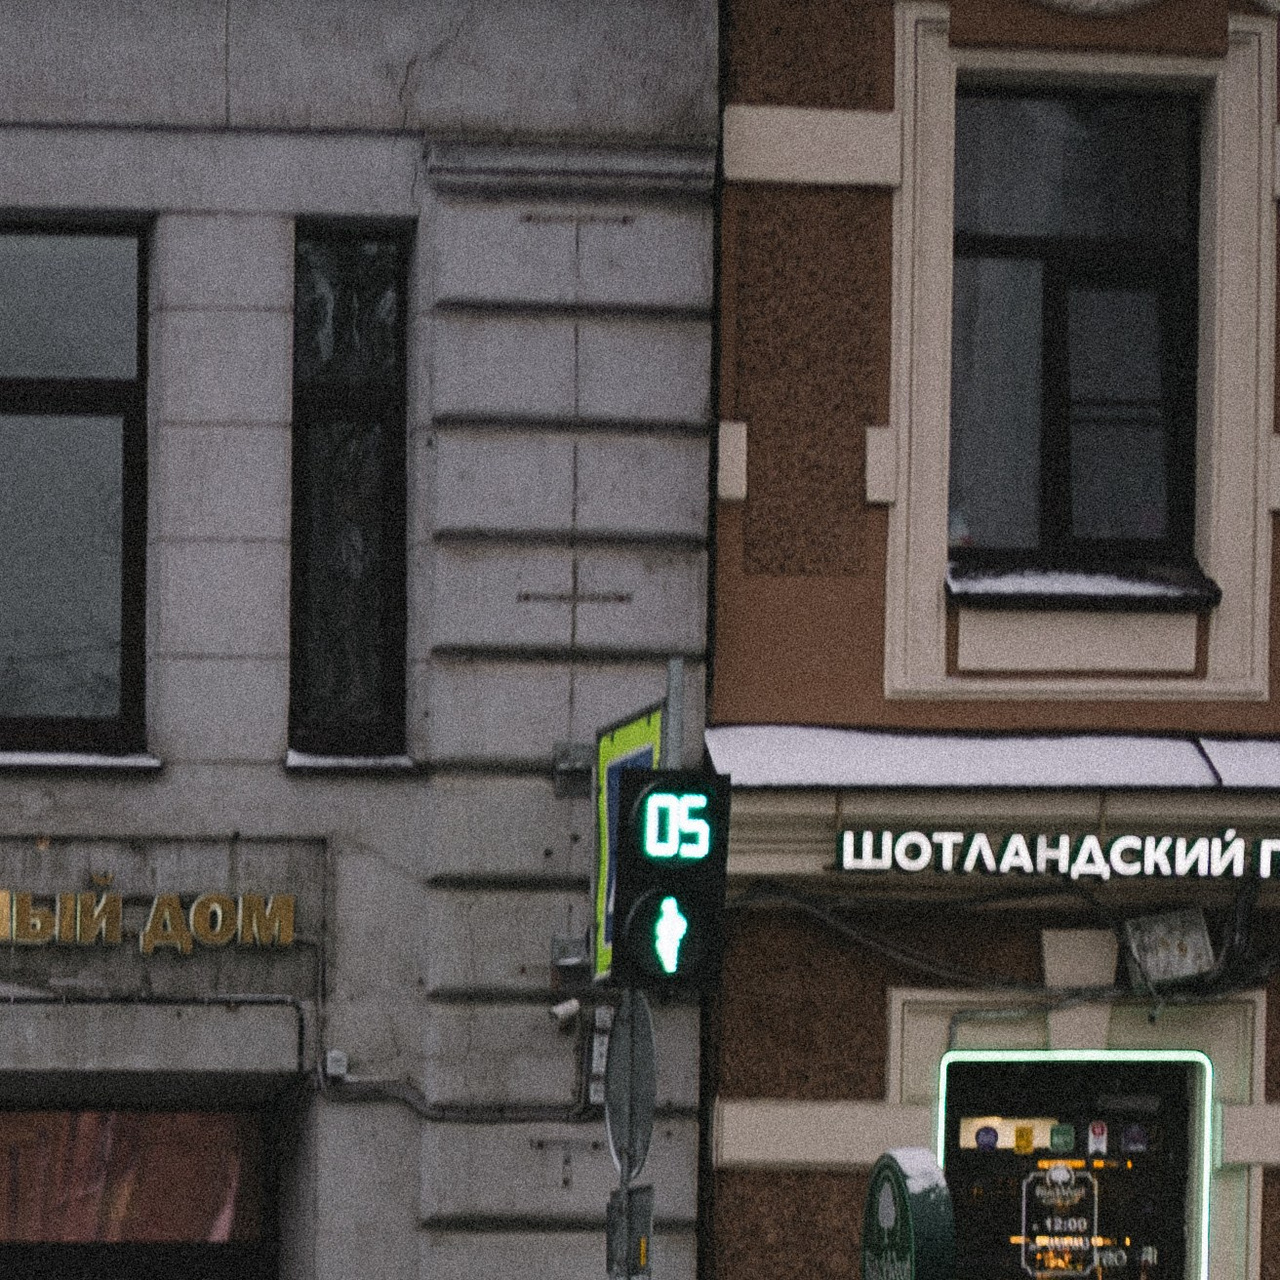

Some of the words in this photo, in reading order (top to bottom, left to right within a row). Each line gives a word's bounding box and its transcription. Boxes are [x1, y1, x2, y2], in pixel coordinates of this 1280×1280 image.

[645, 793, 711, 859] 05
[842, 829, 1246, 881] ШОТЛАНДСКИЙ
[140, 891, 296, 954] ДОМ
[1044, 1216, 1088, 1233] 12:00
